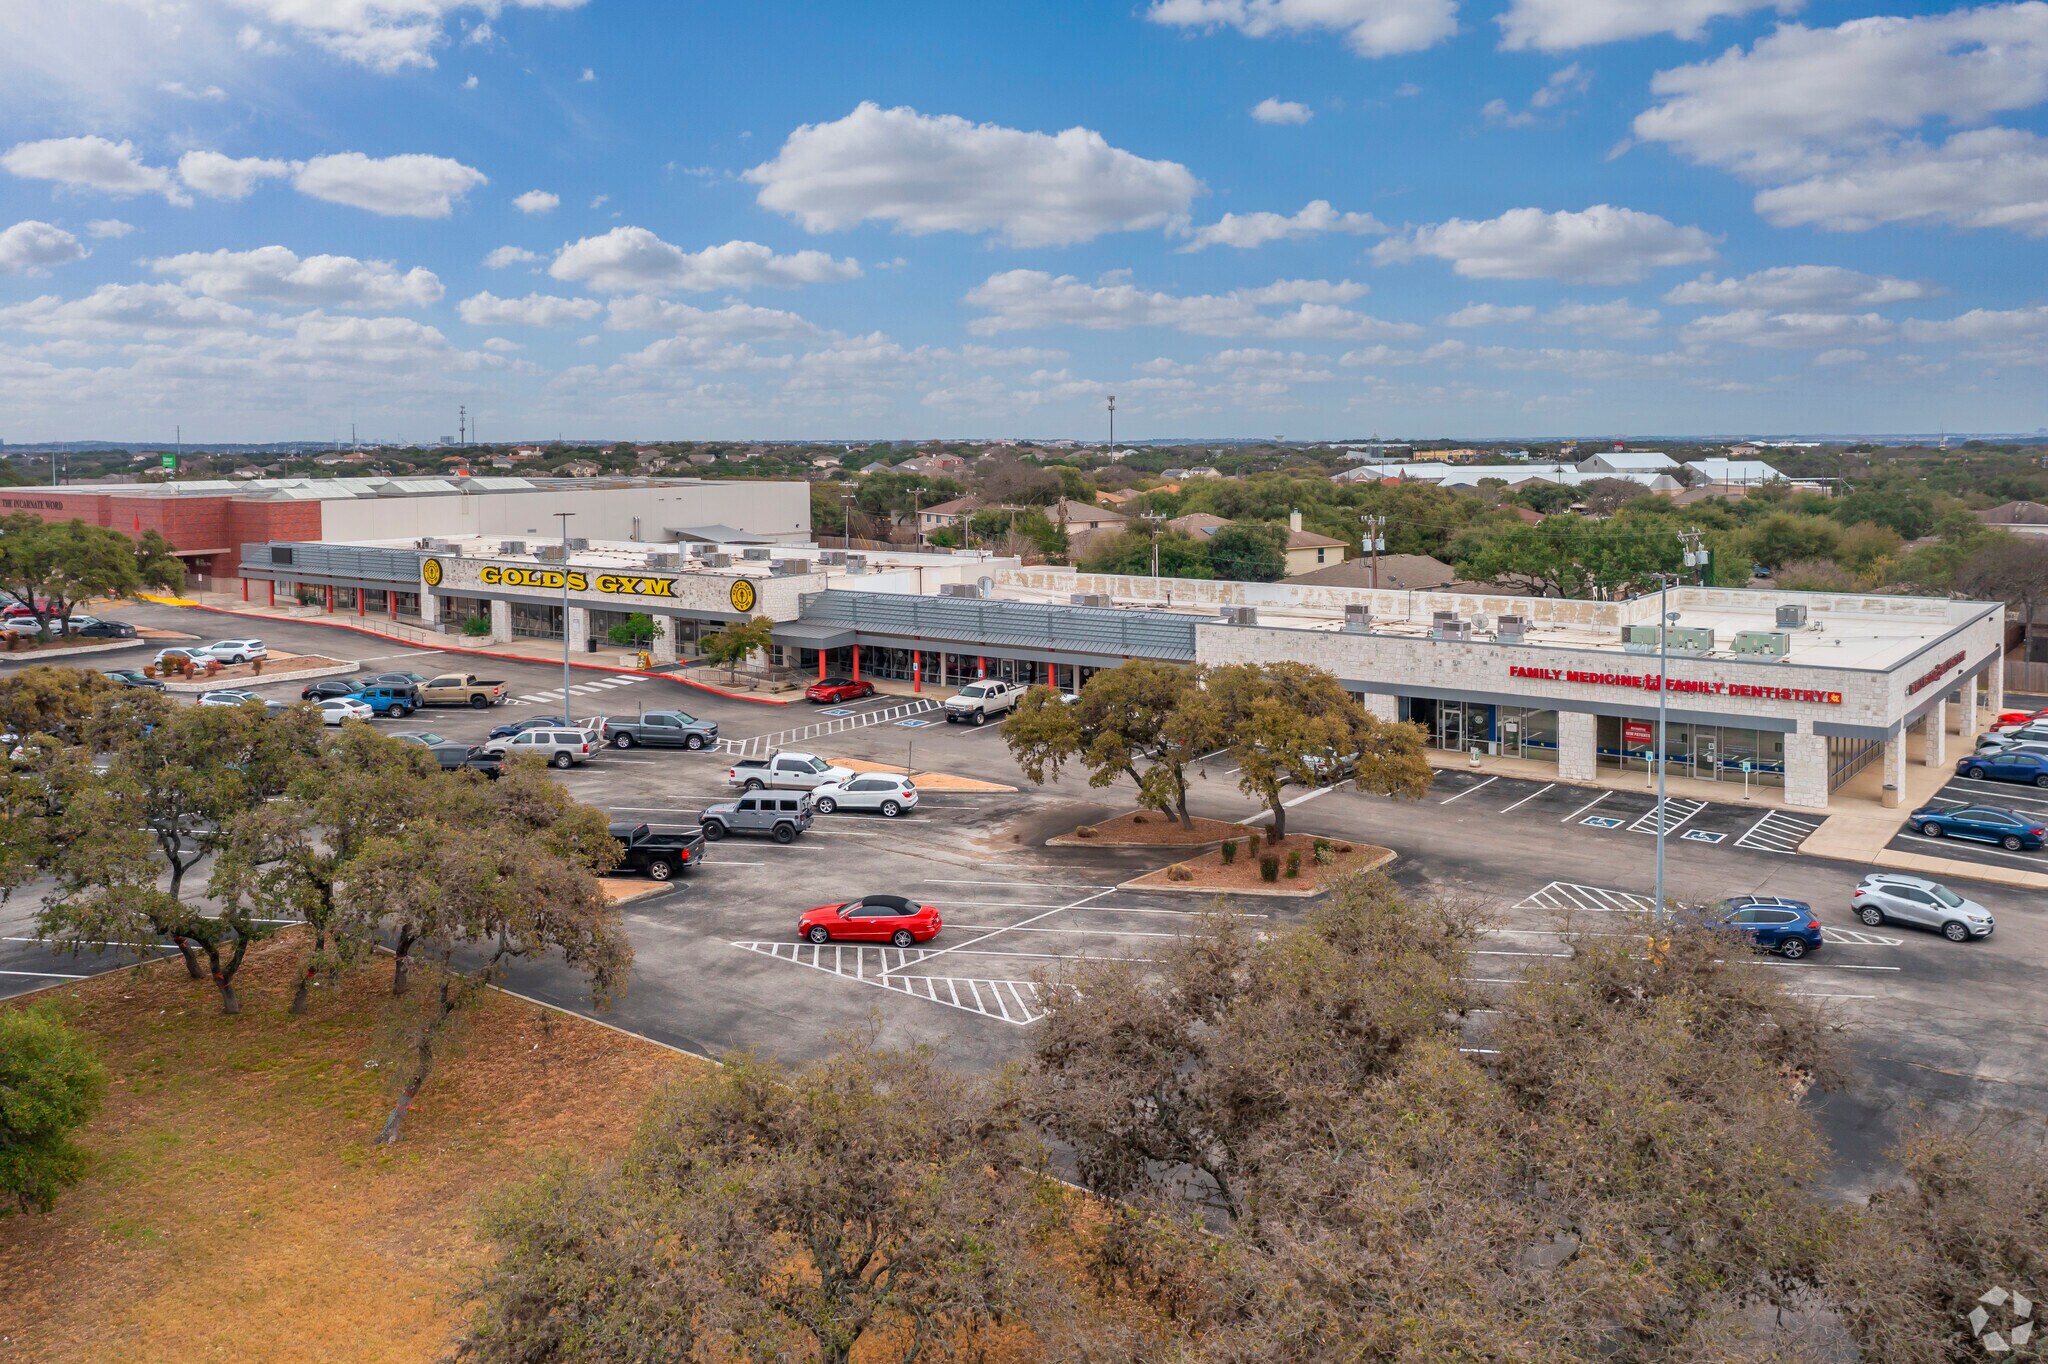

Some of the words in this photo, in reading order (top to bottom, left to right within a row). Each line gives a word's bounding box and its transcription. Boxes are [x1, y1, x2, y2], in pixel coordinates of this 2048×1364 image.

[2, 499, 12, 508] THE
[13, 499, 45, 510] INCARNATE
[45, 500, 63, 510] WORD
[594, 574, 680, 598] GYM
[1509, 665, 1563, 681] FAMILY
[1566, 670, 1643, 689] MEDICINE
[1665, 678, 1724, 695] FAMILY
[1727, 683, 1828, 703] DENTISTRY
